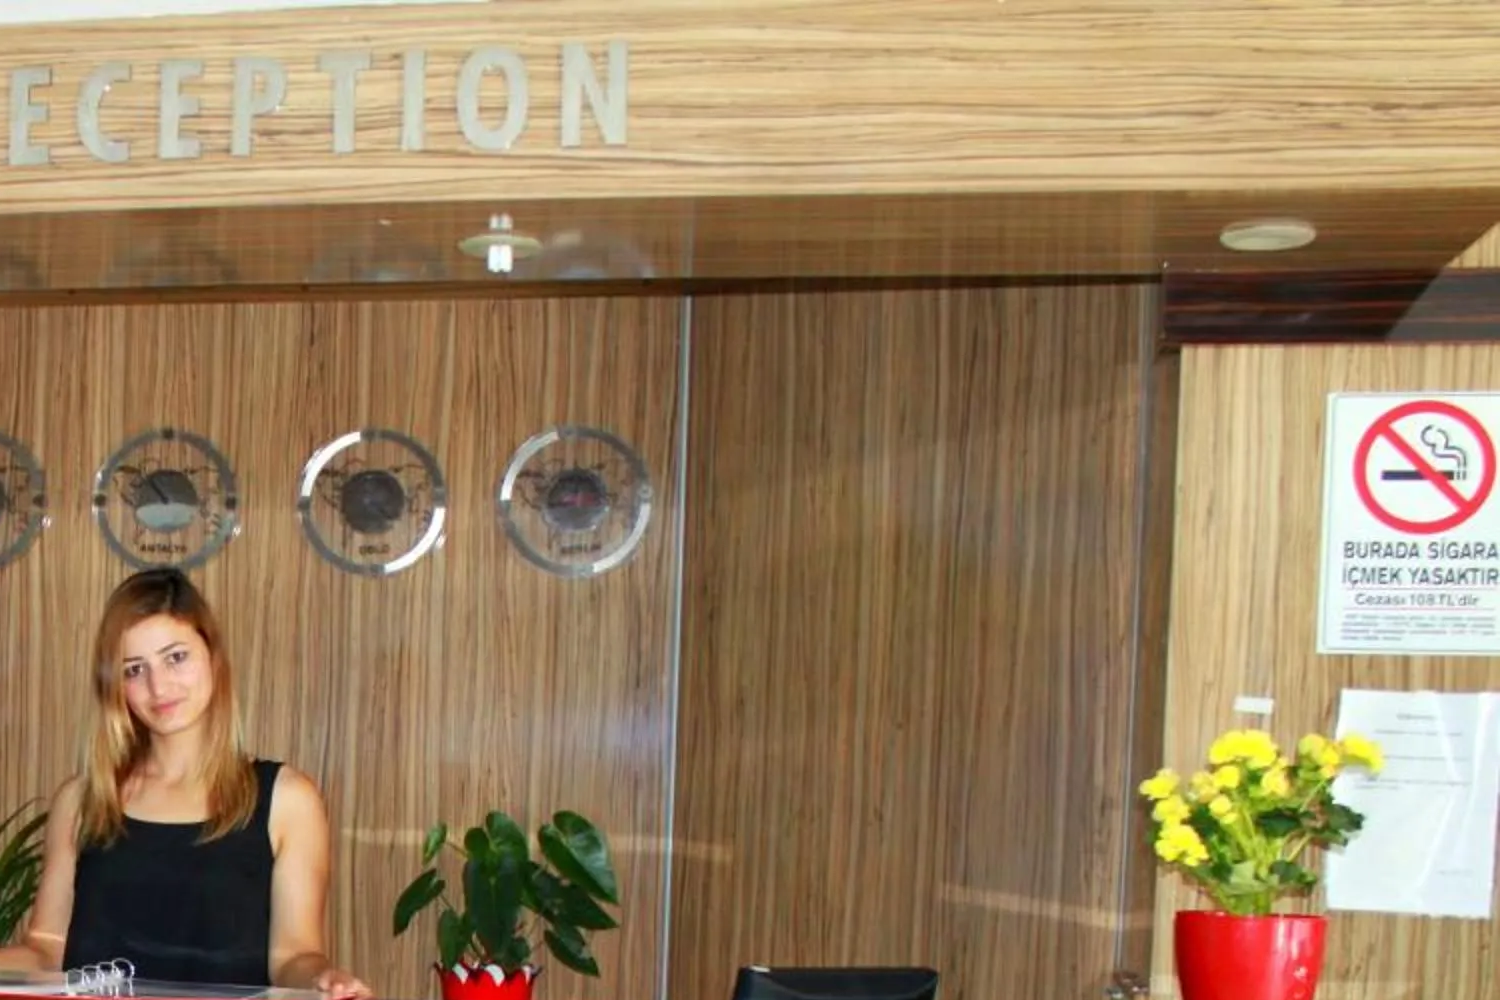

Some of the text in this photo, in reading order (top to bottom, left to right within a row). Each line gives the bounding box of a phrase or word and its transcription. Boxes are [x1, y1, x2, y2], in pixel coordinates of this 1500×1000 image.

[1343, 537, 1500, 559] BURADA SİGARA
[1342, 564, 1500, 588] İÇMEK YASAKTIR
